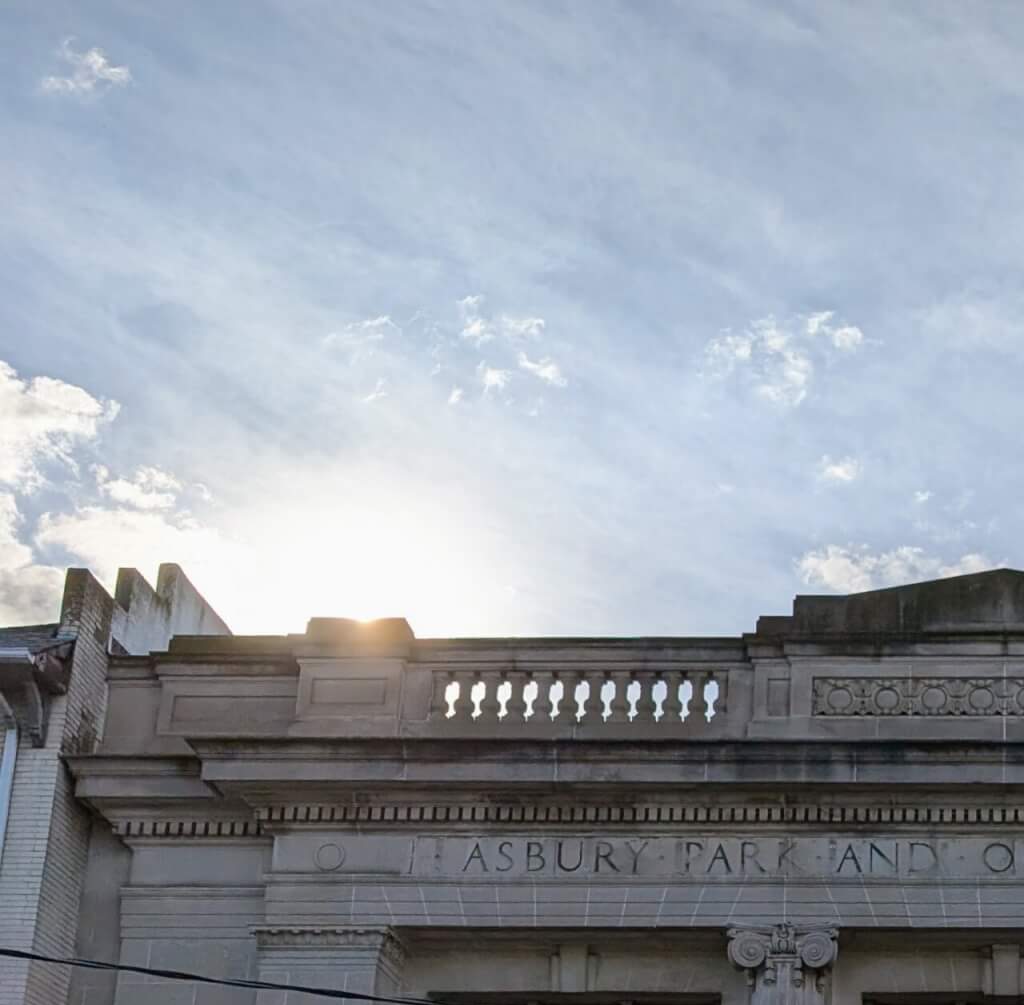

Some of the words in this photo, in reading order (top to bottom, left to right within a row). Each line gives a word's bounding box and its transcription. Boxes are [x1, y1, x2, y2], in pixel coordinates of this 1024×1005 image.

[461, 841, 649, 874] ASBURY
[684, 841, 808, 874] PARK
[836, 841, 939, 874] AND
